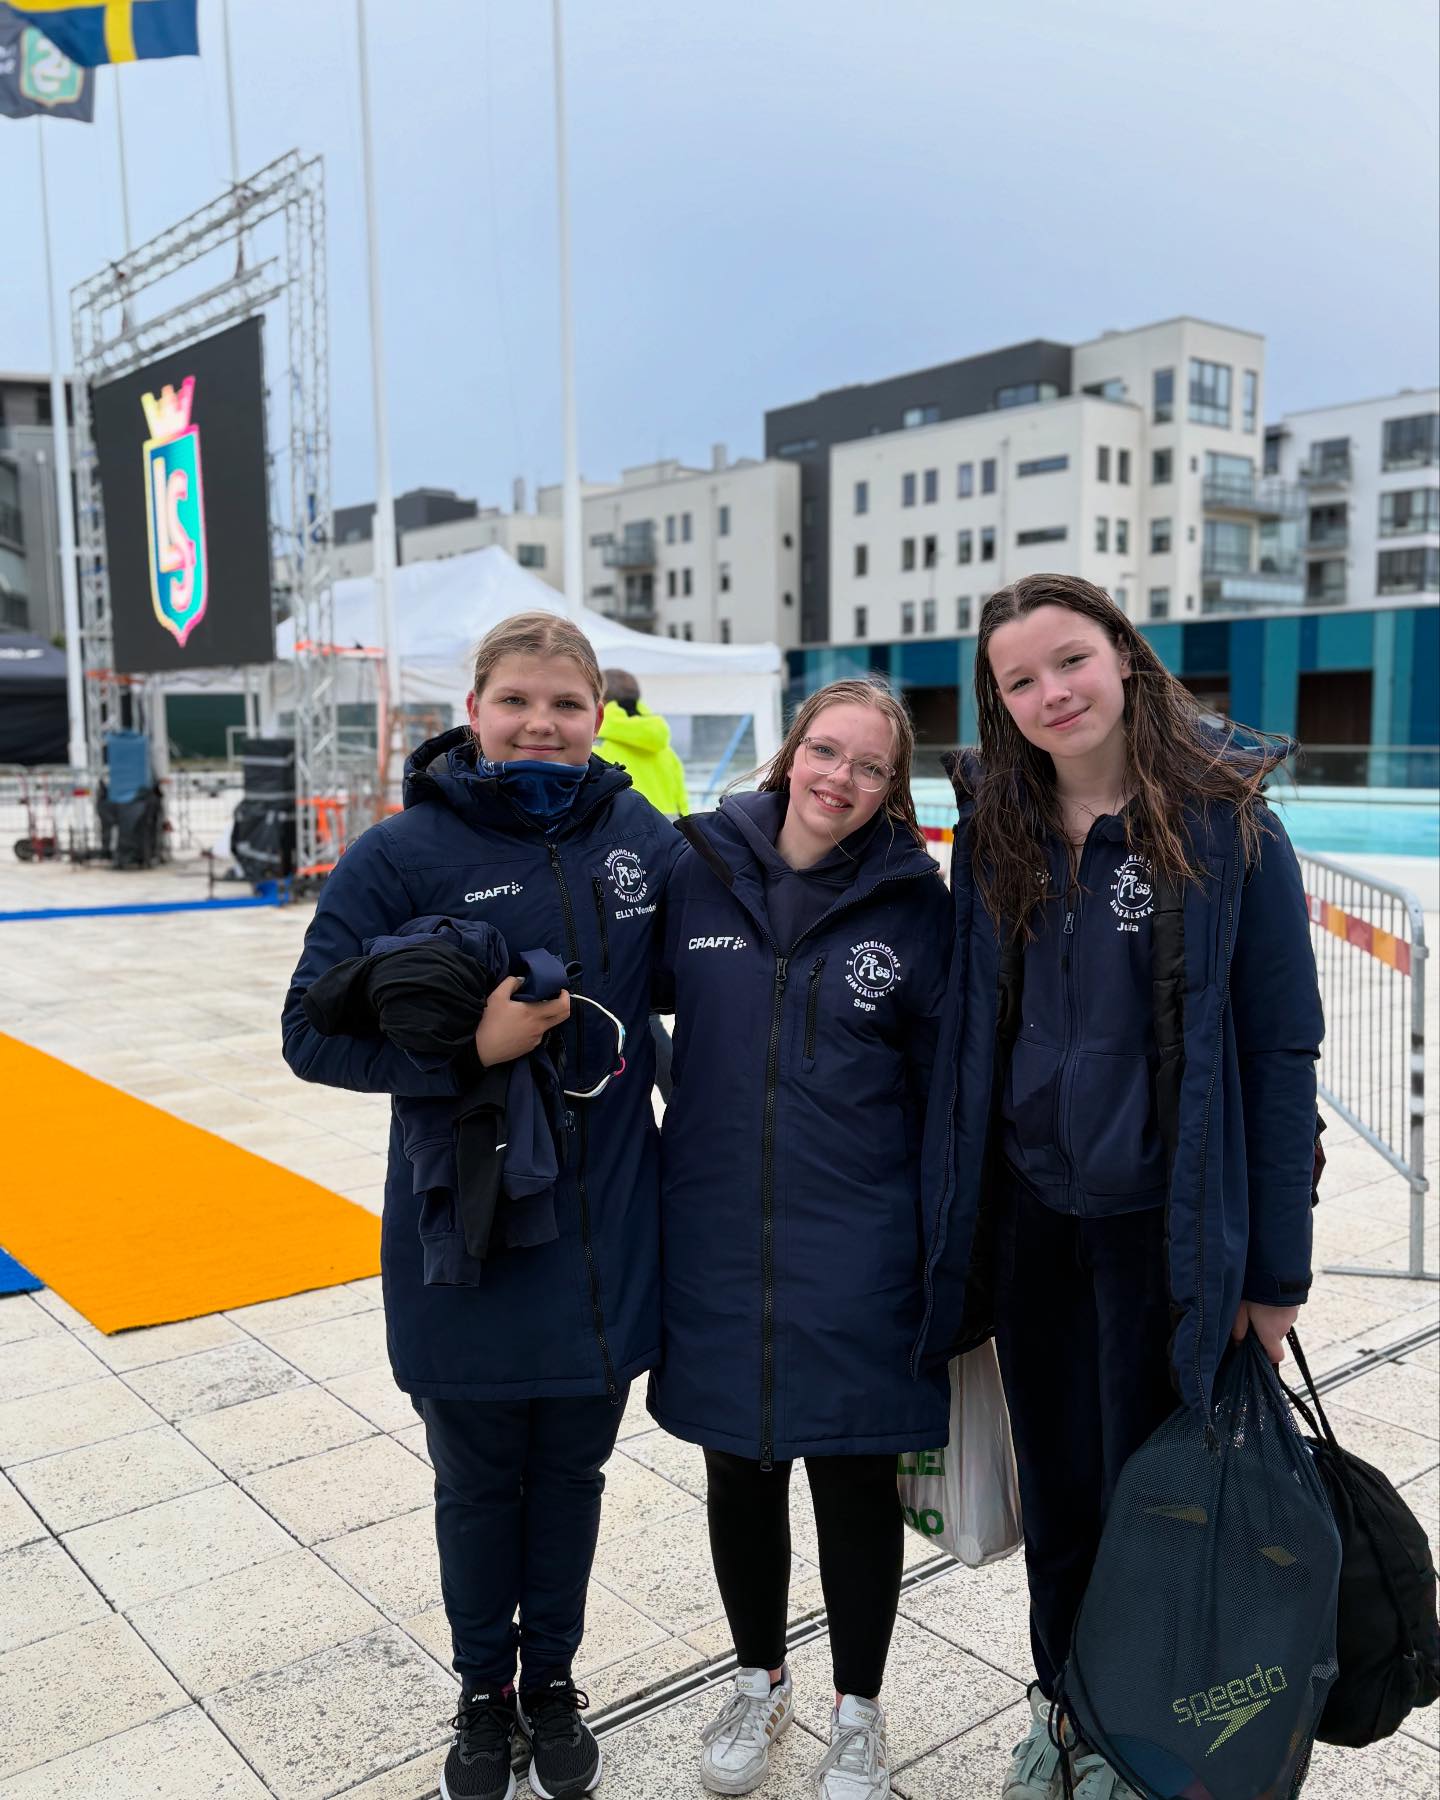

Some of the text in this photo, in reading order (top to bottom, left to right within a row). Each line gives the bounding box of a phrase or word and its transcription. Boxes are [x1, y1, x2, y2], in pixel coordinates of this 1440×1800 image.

[464, 884, 511, 903] CRAFT
[615, 908, 635, 921] ELLY
[688, 936, 735, 950] CRAFT
[849, 940, 901, 969] ÄNGELHOLMS
[853, 998, 877, 1012] Saga
[1172, 1663, 1288, 1727] speedo
